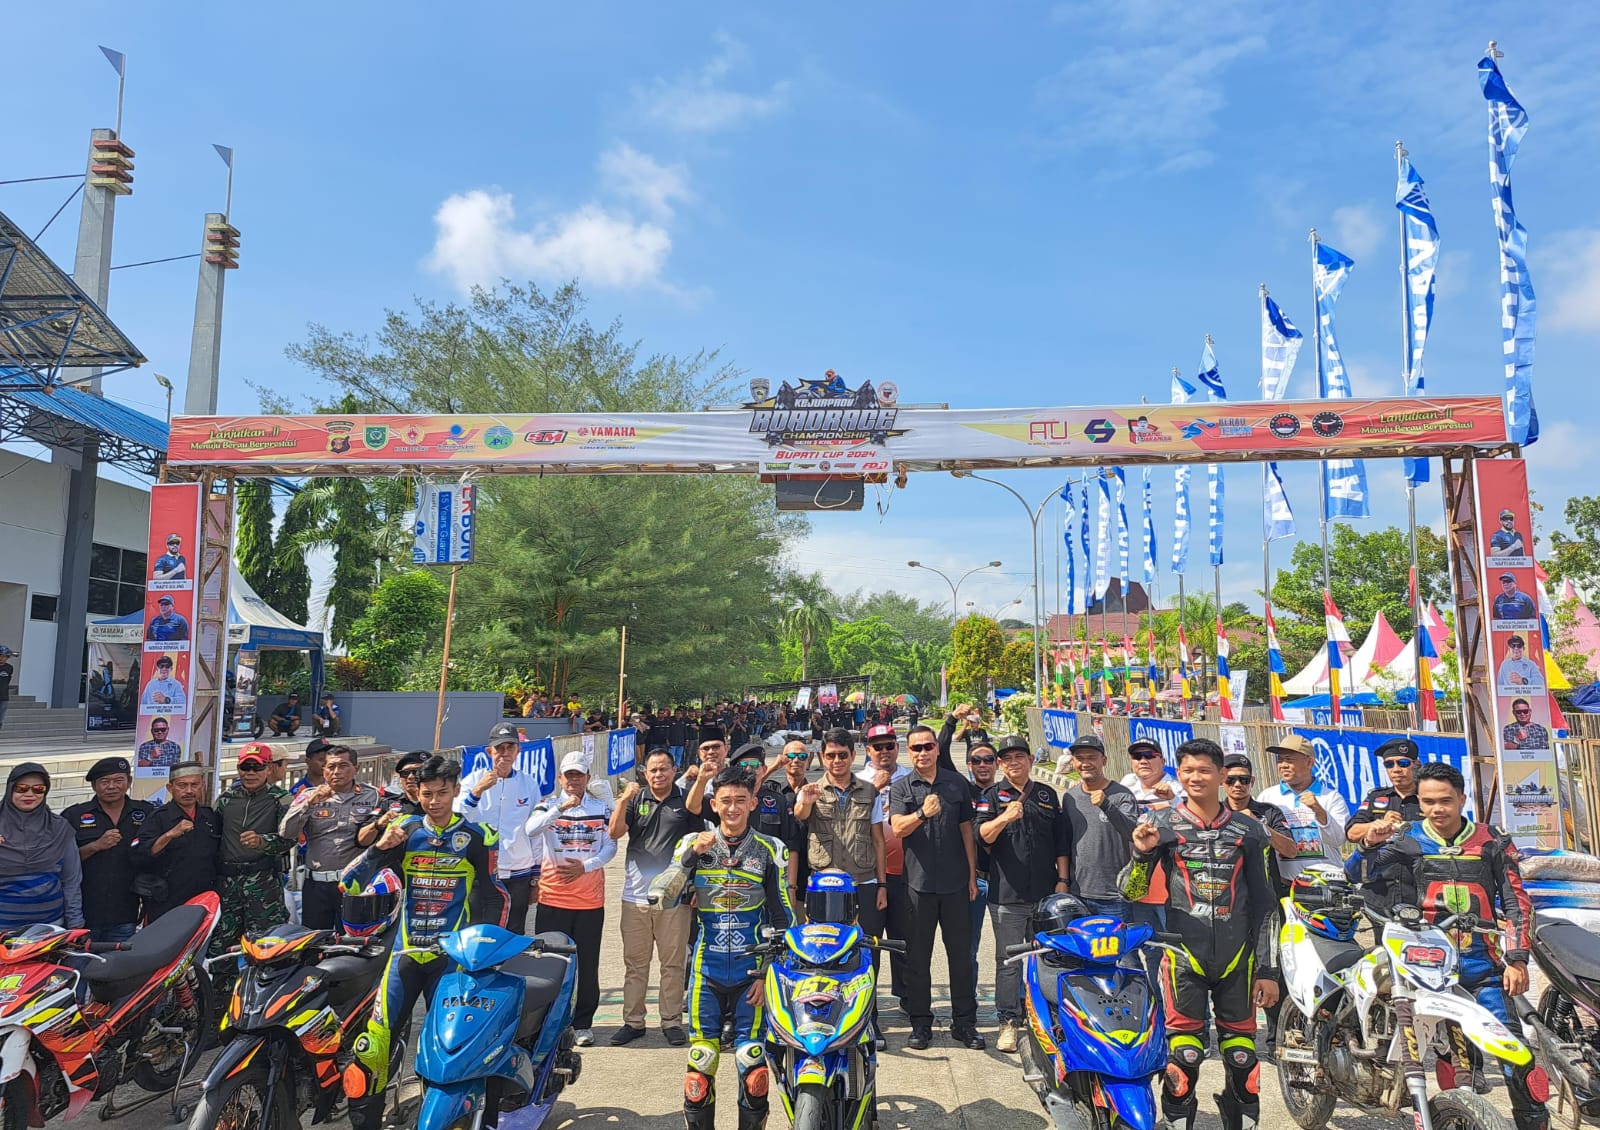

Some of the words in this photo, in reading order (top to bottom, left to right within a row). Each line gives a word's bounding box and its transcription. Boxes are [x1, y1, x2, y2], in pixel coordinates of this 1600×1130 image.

[750, 409, 898, 432] ROADRACE
[1380, 410, 1438, 424] Lanjutkan
[209, 429, 265, 441] Lanjutkan
[590, 426, 636, 437] YAMAHA
[190, 441, 221, 450] Menuju
[222, 441, 249, 449] Berau
[775, 451, 820, 459] BUPATI
[822, 451, 844, 459] CUP
[847, 450, 877, 458] 2024
[439, 505, 449, 528] Years
